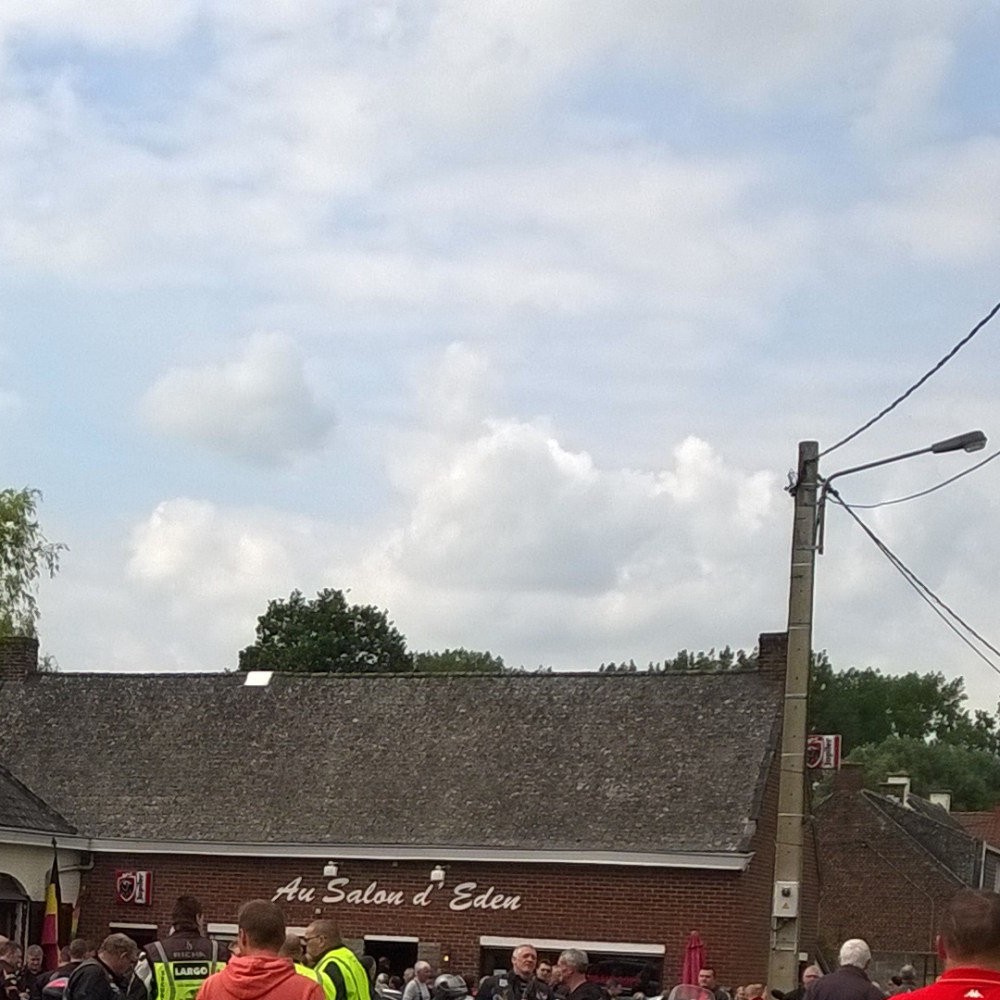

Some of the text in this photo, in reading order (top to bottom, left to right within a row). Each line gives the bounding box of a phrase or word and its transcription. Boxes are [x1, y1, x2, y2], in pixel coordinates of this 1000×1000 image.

[271, 876, 316, 902] Au
[322, 878, 404, 907] Salon
[449, 882, 522, 911] Eden
[174, 966, 208, 976] LARGO
